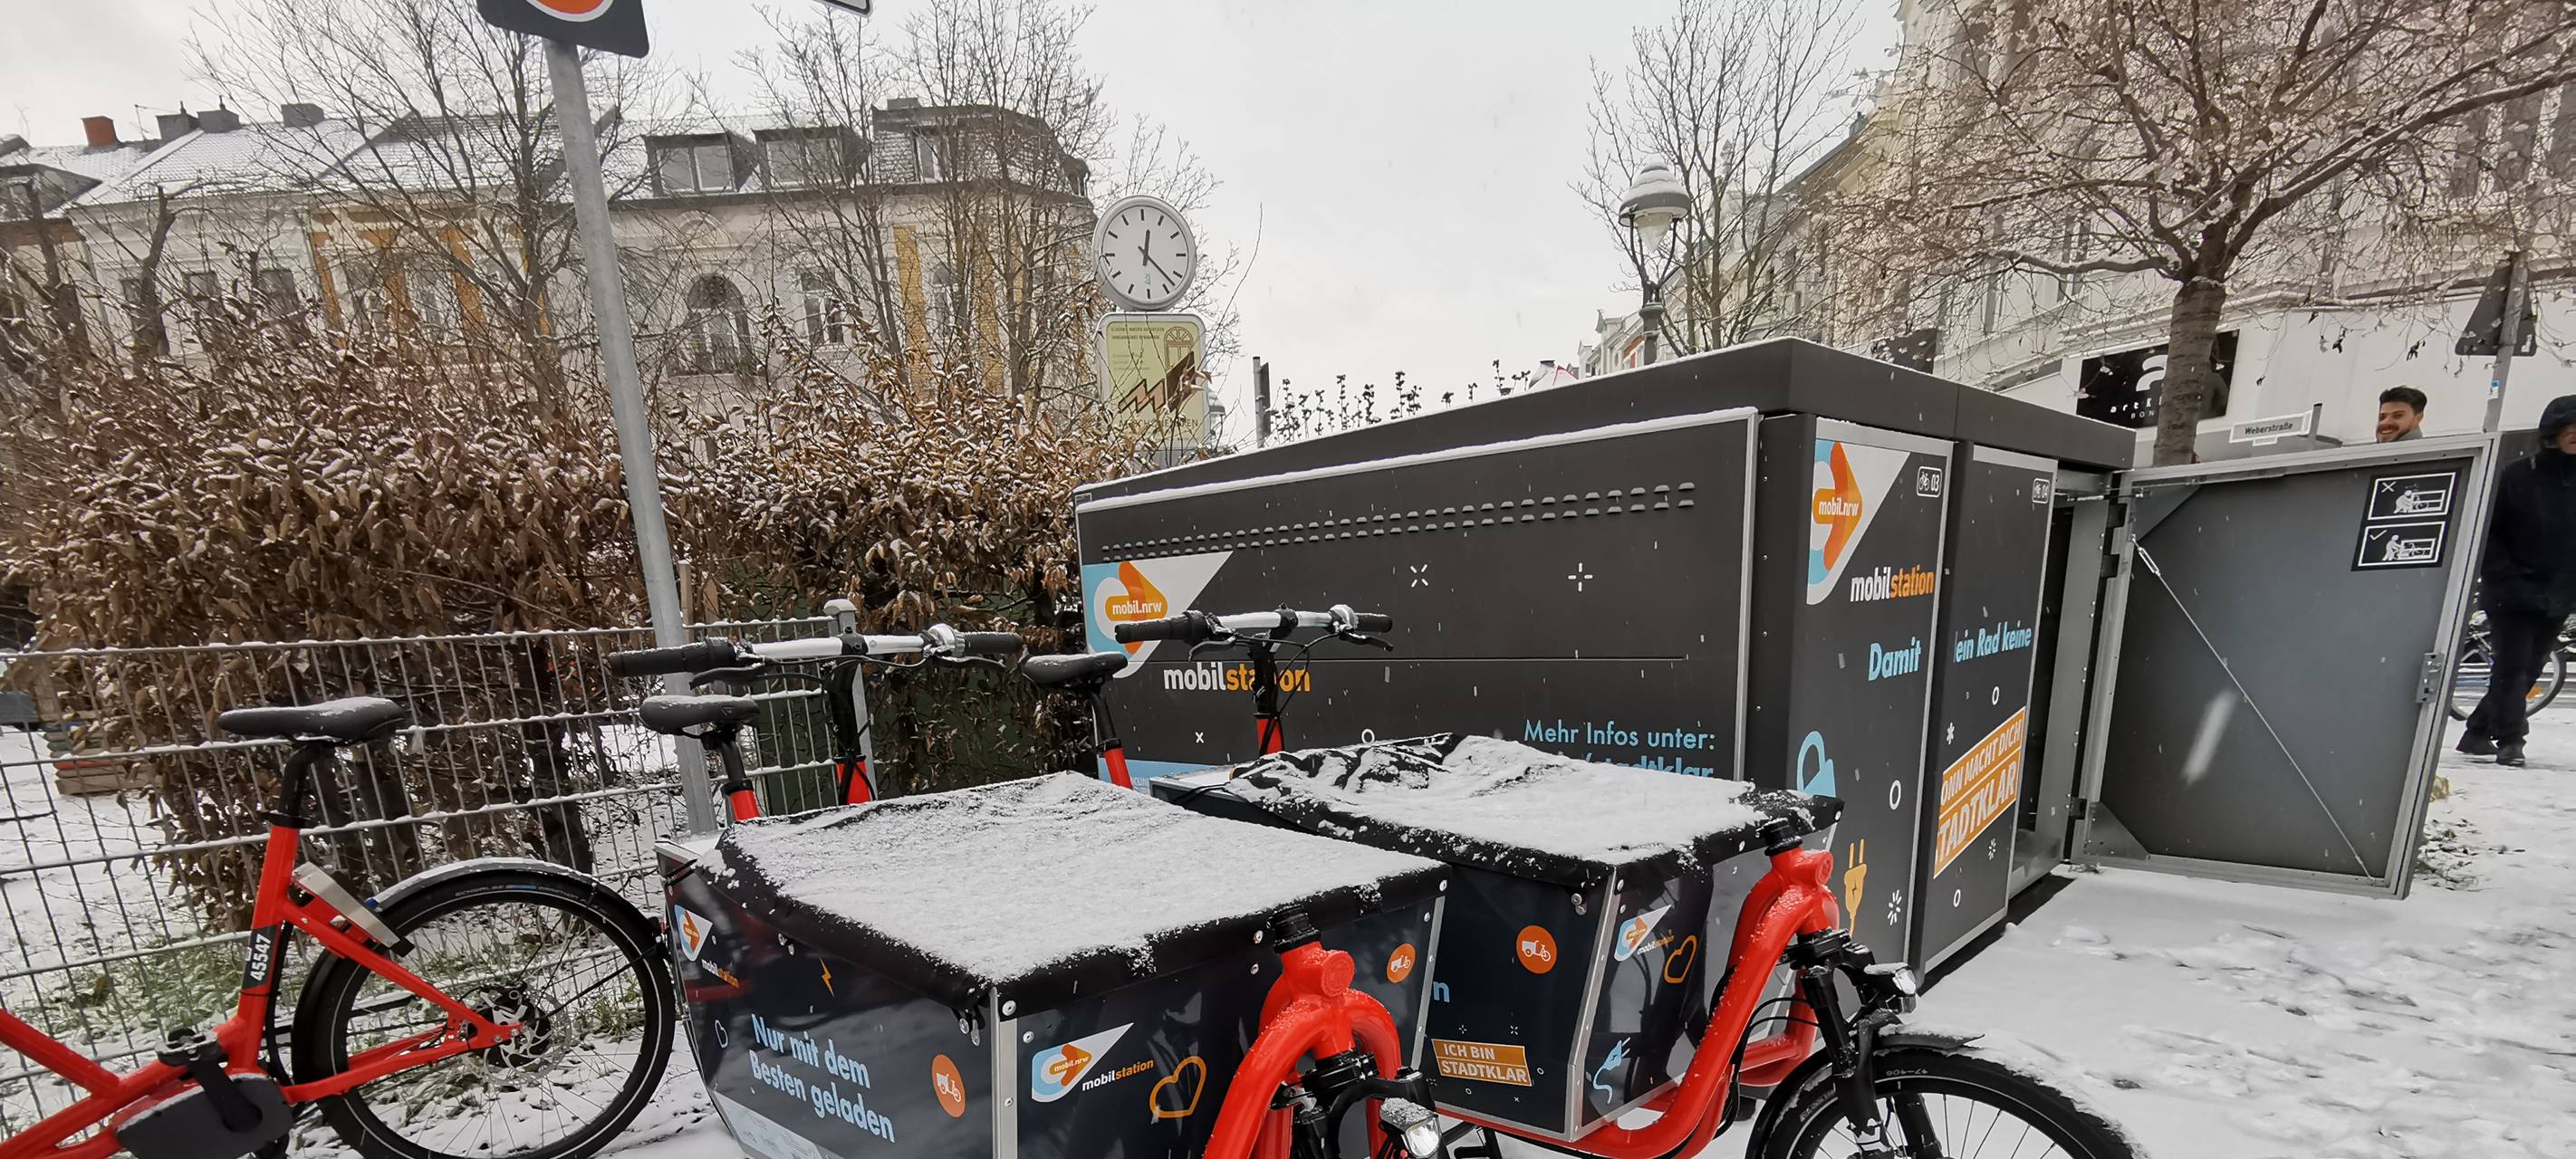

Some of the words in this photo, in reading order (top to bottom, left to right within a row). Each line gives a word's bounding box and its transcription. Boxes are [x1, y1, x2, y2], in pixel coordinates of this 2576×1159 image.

[2244, 421, 2293, 436] Weberstraße
[1930, 474, 1940, 492] 03
[1818, 496, 1860, 517] mobil.nrw
[1850, 564, 1935, 602] mobilstation
[1111, 599, 1162, 616] mobil.nrw
[1954, 629, 1975, 663] ein
[1976, 622, 2002, 657] Rad
[2002, 619, 2032, 652] keine
[1868, 636, 1922, 682] Damit
[1163, 661, 1312, 693] mobilston
[1523, 719, 1579, 743] Mehr
[1587, 721, 1639, 747] Infos
[1647, 727, 1716, 751] unter:
[1964, 737, 2000, 786] MACHT
[1998, 719, 2023, 757] DICH
[1937, 761, 2018, 863] TADTKLAR
[250, 934, 272, 982] 45547
[751, 1013, 785, 1053] Nur
[789, 1030, 820, 1068] mit
[824, 1039, 870, 1088] dem
[1053, 1055, 1090, 1072] mobil.nrw
[1443, 1043, 1467, 1058] ICH
[1470, 1045, 1495, 1060] BIN
[1081, 1059, 1155, 1092] mobilstation
[1441, 1059, 1528, 1083] STADTKLAR
[748, 1049, 807, 1102] Besten
[811, 1081, 896, 1144] geladen
